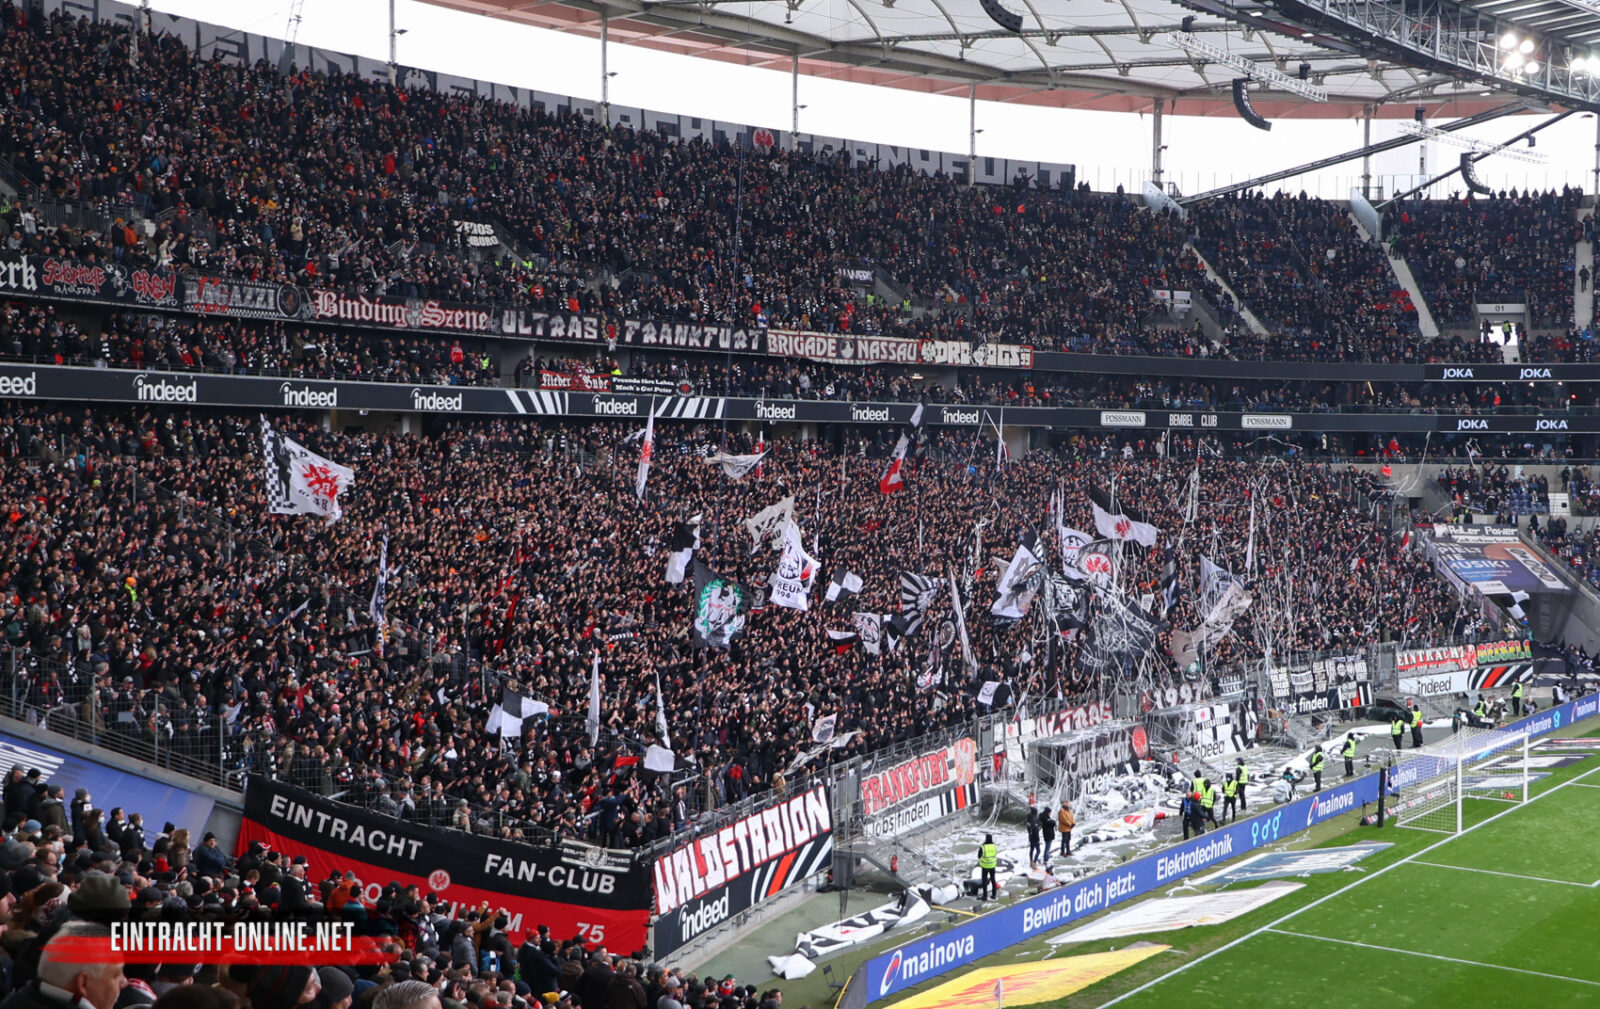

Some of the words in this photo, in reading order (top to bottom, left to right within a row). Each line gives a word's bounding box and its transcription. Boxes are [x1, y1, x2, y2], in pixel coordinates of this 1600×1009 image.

[184, 279, 276, 310] RAGAZZI
[312, 289, 409, 328] Binding
[419, 300, 490, 331] Szene
[501, 309, 598, 340] ULTRAS
[623, 319, 765, 350] FRANKFURT
[767, 332, 836, 358] BRIGADE
[857, 338, 917, 362] NASSAU
[1442, 368, 1474, 380] JOKA
[1519, 368, 1552, 380] JOKA
[136, 376, 197, 402] indeed
[282, 382, 338, 407] indeed
[413, 390, 462, 411] indeed
[594, 397, 637, 415] indeed
[756, 402, 796, 420] indeed
[851, 405, 889, 421] indeed
[942, 408, 979, 424] indeed
[1169, 412, 1194, 426] BEMBEL
[1201, 413, 1218, 426] CLUB
[1456, 419, 1489, 431] JOKA
[1535, 419, 1569, 431] JOKA
[1299, 694, 1328, 713] finden
[1036, 702, 1113, 738] ULTRAS
[861, 749, 950, 815] FRANKFURT
[1318, 790, 1354, 818] mainova
[269, 794, 424, 861] EINTRACHT
[653, 785, 832, 915] WALDSTADION
[1156, 833, 1234, 882] Elektrotechnik
[484, 853, 616, 895] FAN-CLUB
[680, 886, 730, 943] indeed
[1023, 897, 1071, 934] Bewirb
[1074, 886, 1102, 918] dich
[1104, 874, 1136, 910] jetzt:
[576, 922, 605, 944] 75
[902, 933, 974, 981] mainova
